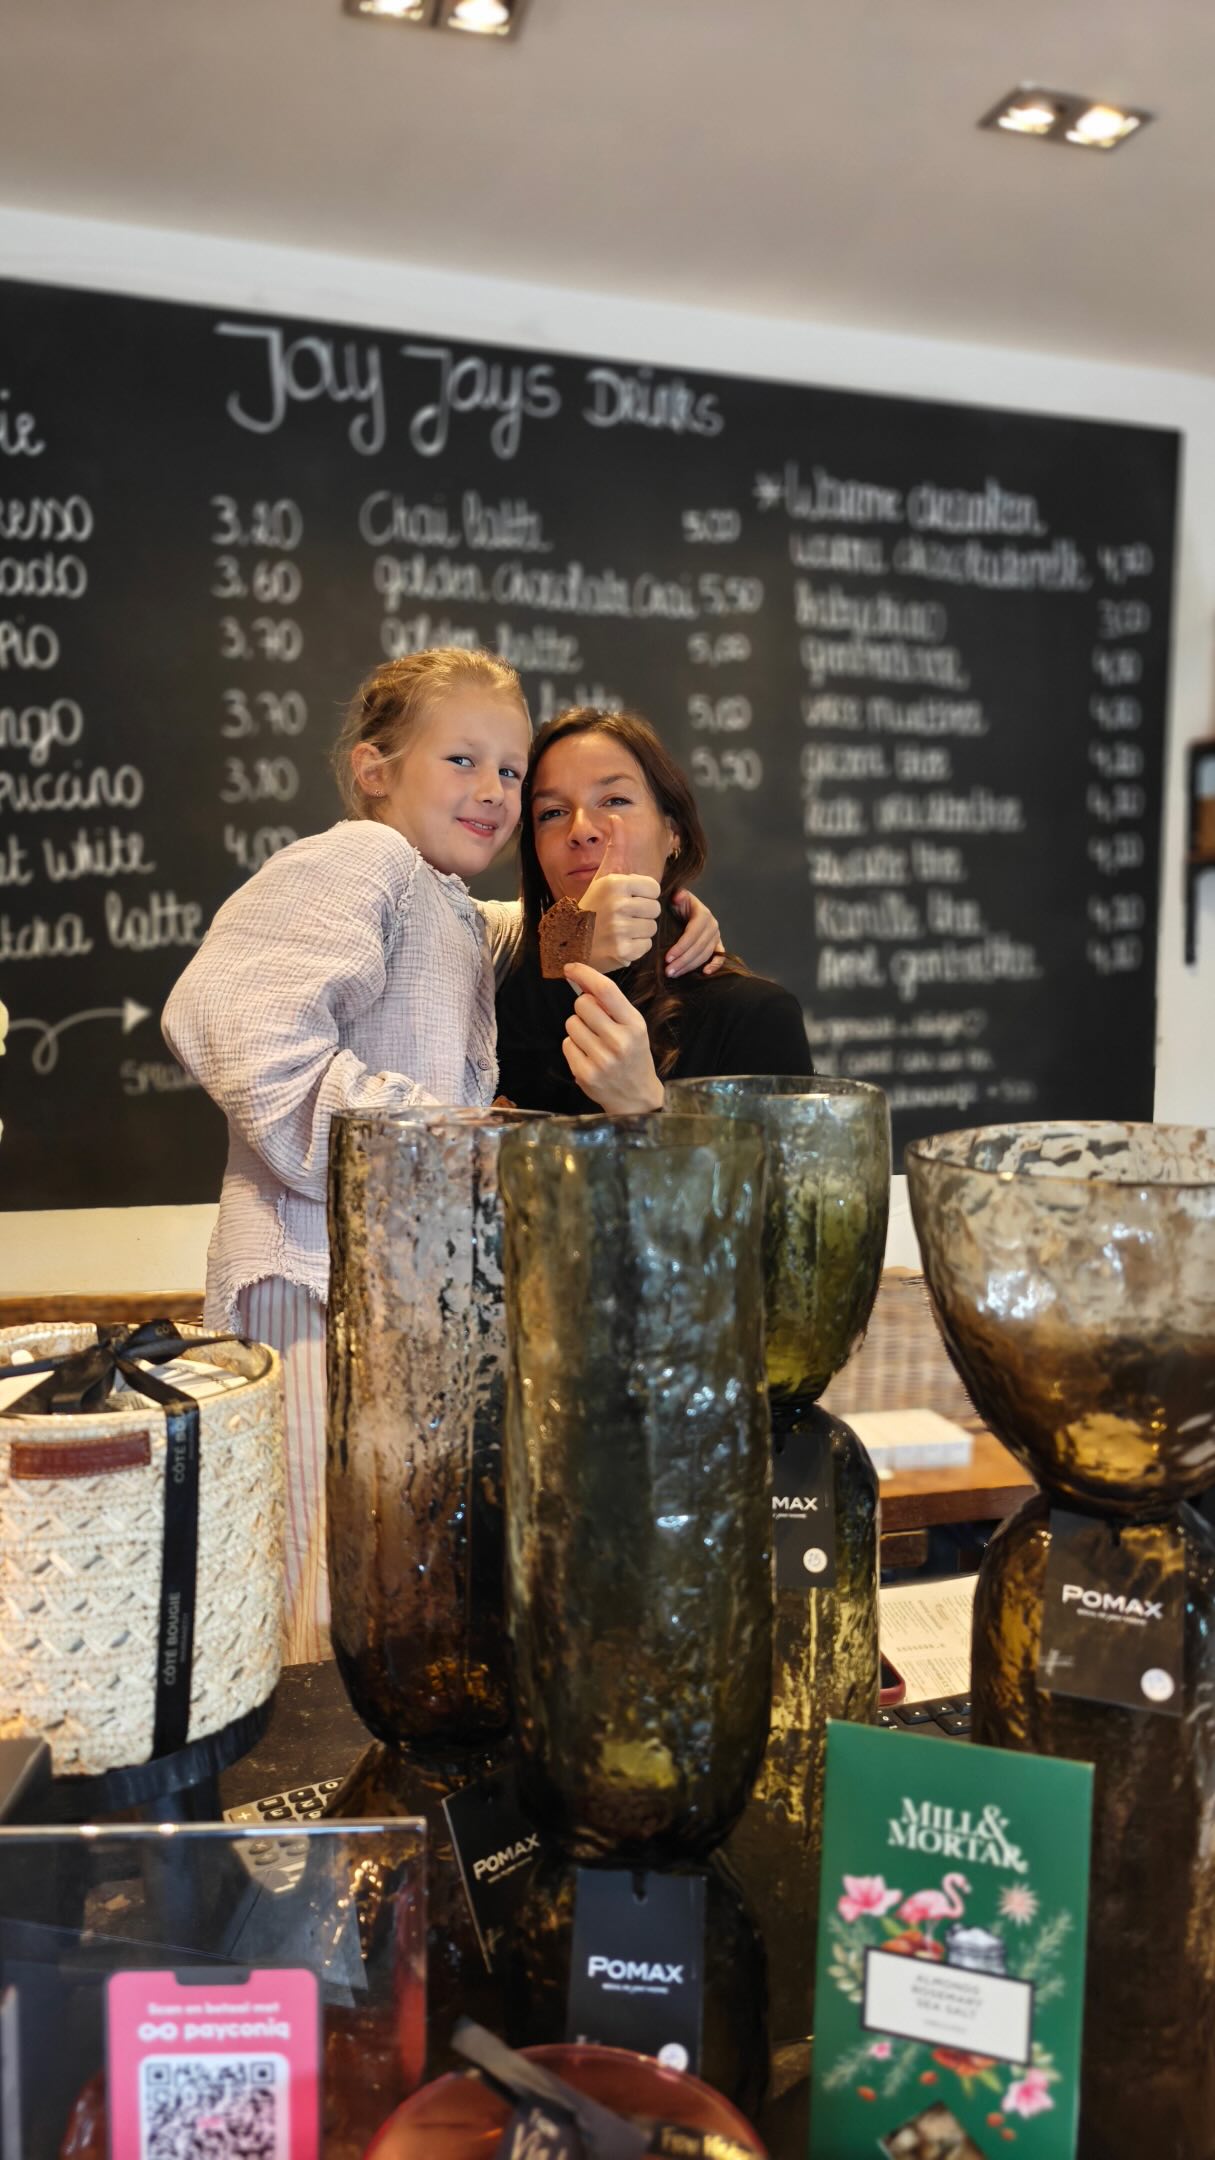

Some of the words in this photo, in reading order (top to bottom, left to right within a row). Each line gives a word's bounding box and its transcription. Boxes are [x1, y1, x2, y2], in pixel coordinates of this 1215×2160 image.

[214, 320, 387, 456] Jay
[402, 345, 562, 460] Jays
[360, 489, 460, 546] Chai
[42, 824, 157, 883] white
[104, 889, 208, 953] latte
[771, 1495, 819, 1512] MAX
[166, 1591, 181, 1646] BOUGIE
[1062, 1584, 1164, 1620] POMAX
[473, 1832, 541, 1881] POMAX
[888, 1818, 1029, 1874] MORTAR
[586, 1955, 685, 1985] POMAX
[183, 2018, 291, 2043] payconiq
